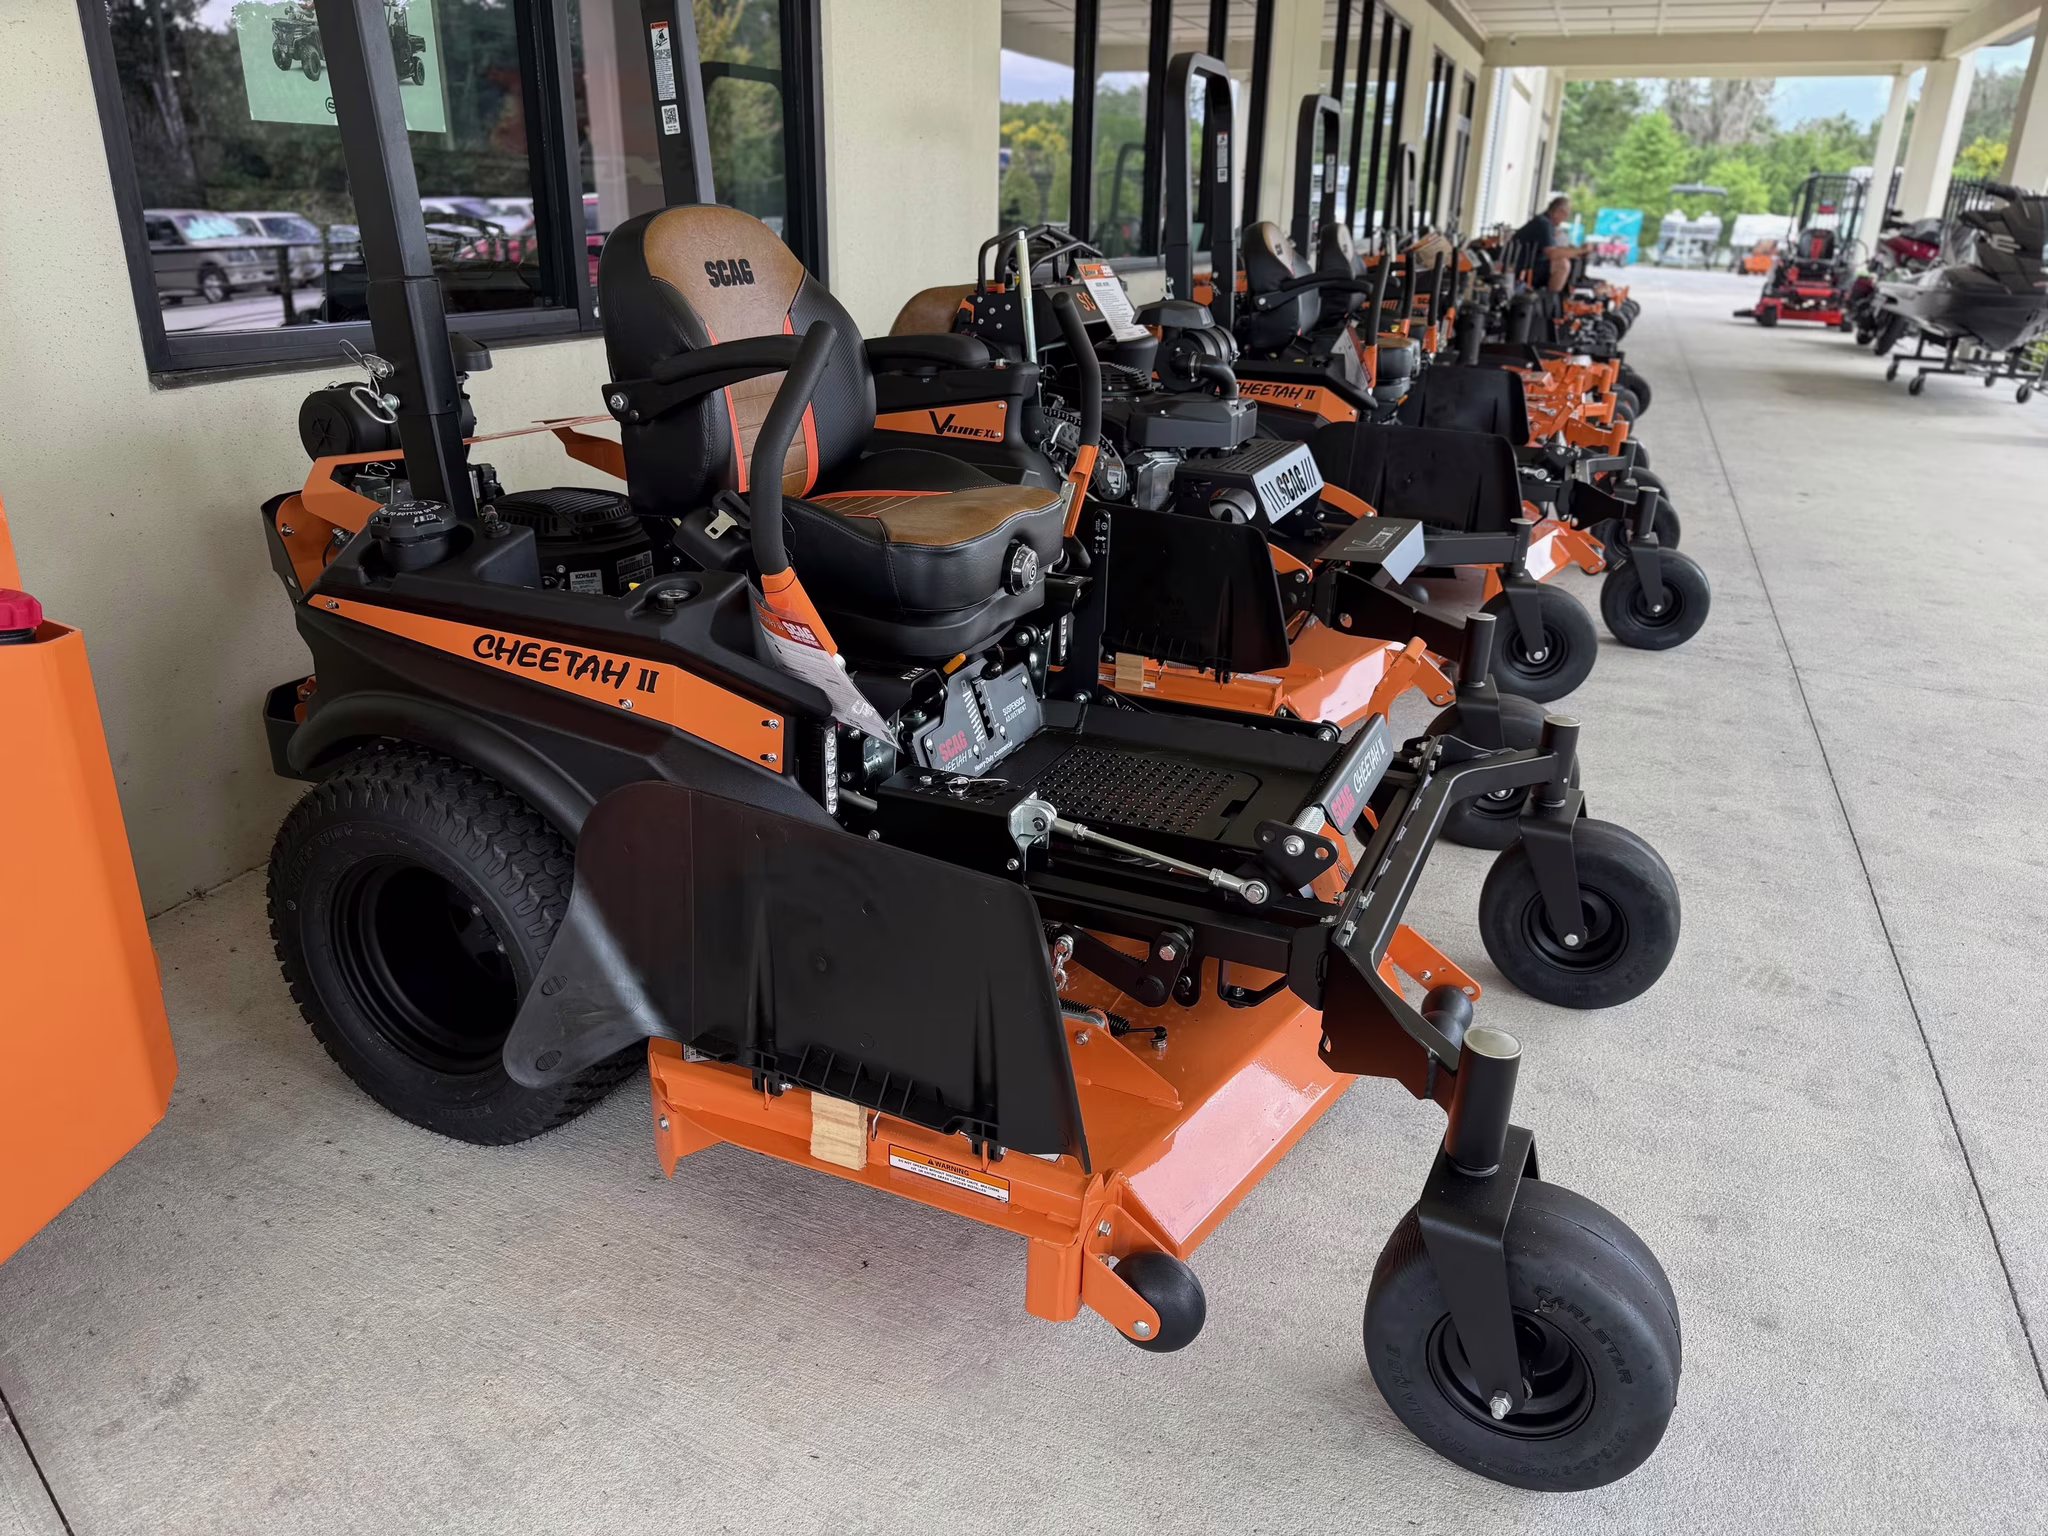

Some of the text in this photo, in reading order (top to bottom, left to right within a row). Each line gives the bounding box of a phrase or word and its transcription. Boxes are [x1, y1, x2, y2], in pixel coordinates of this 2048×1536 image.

[703, 258, 755, 288] SCAG
[1276, 465, 1307, 505] SCAG
[781, 620, 817, 641] SCAG
[473, 634, 660, 694] CHEETAH II
[1002, 695, 1026, 716] SUSPENSION
[1005, 703, 1027, 723] ADJUSTMENT
[939, 730, 968, 762] SCAG
[1332, 785, 1355, 827] SCAG
[1353, 744, 1382, 793] CHEETAH
[935, 1161, 970, 1176] WARNING
